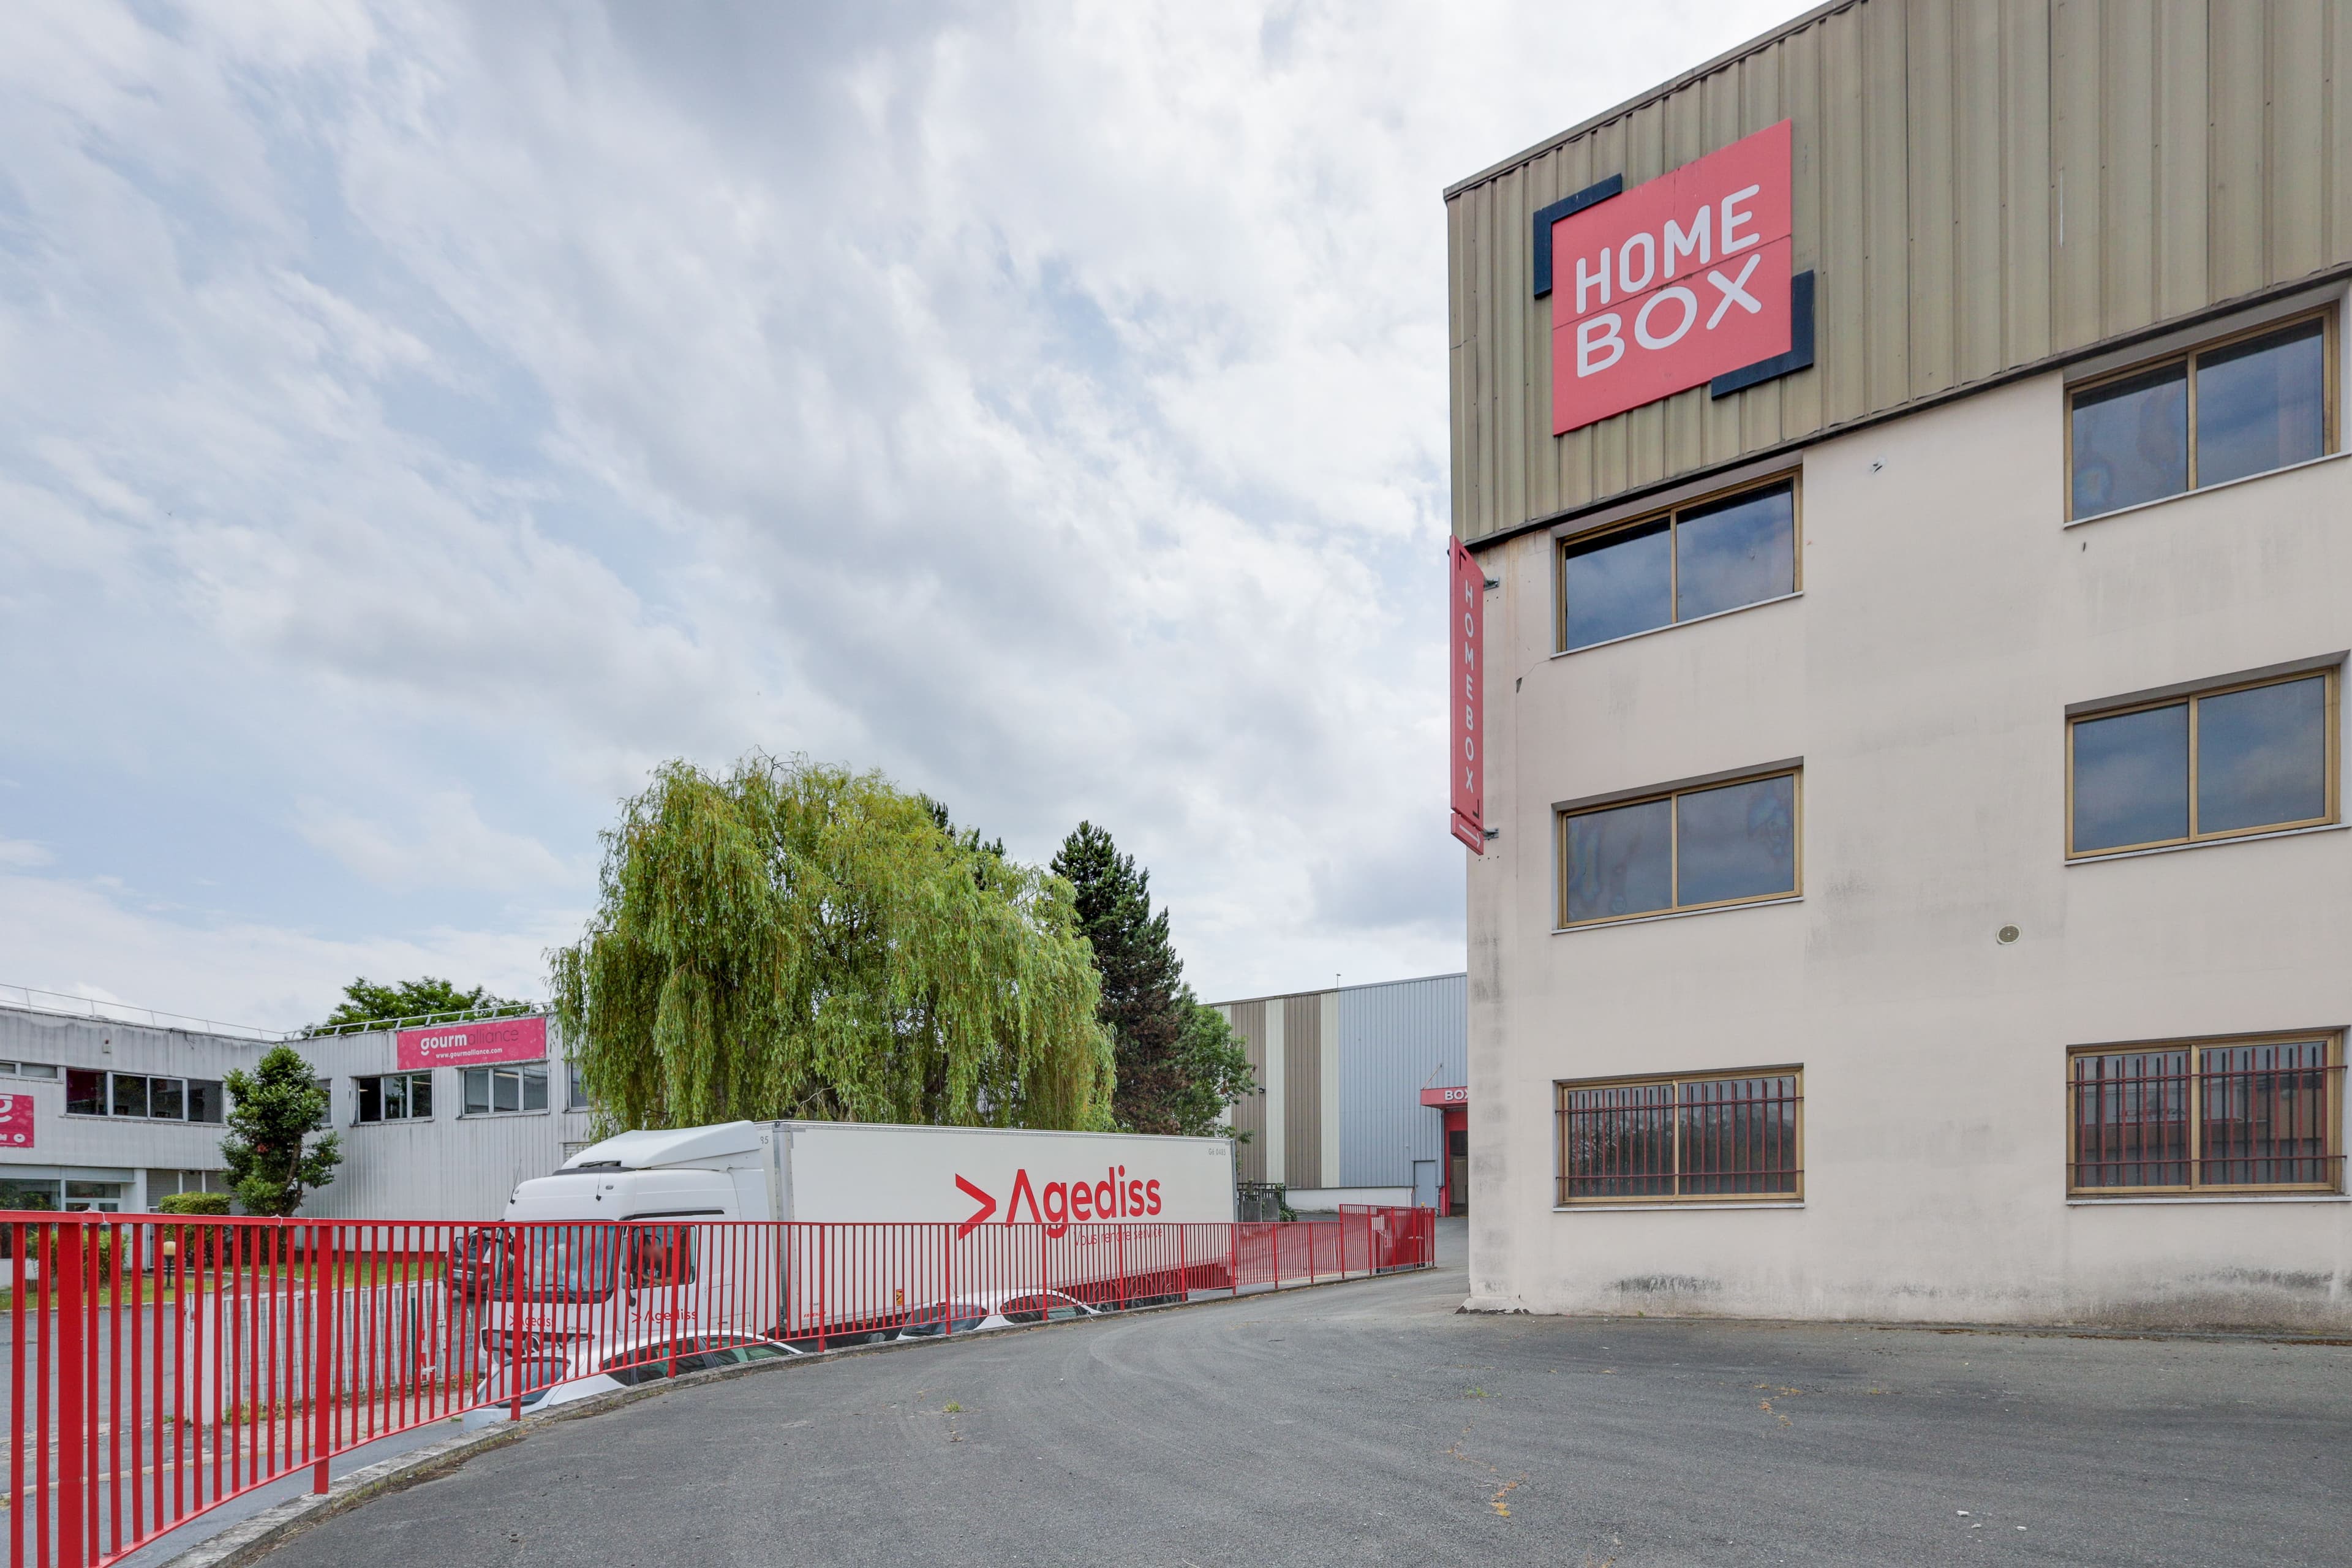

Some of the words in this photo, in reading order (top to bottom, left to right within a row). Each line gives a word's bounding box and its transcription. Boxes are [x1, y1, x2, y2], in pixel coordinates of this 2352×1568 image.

[1576, 184, 1760, 314] HOME
[1577, 254, 1762, 378] BOX
[1464, 579, 1475, 794] HOMEBOX
[435, 1047, 503, 1059] www.gourmalliance.com
[1005, 1165, 1162, 1239] Agediss
